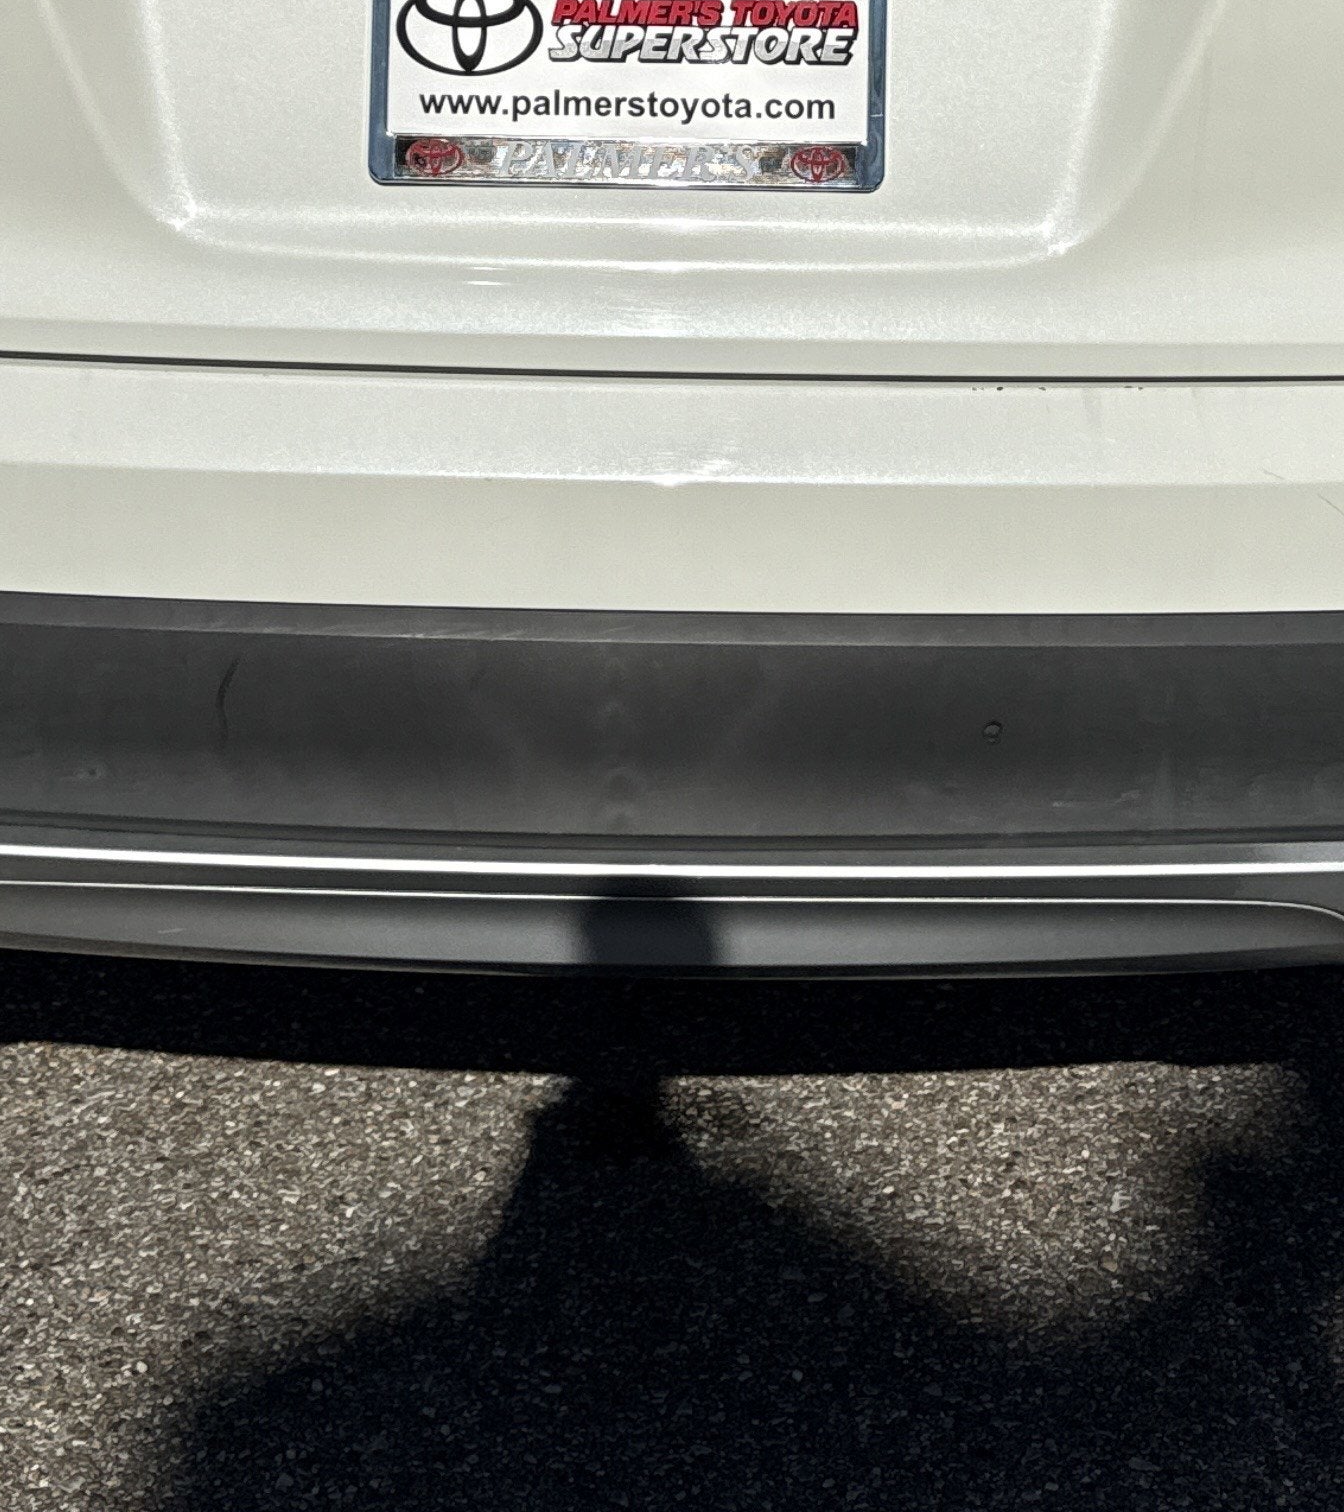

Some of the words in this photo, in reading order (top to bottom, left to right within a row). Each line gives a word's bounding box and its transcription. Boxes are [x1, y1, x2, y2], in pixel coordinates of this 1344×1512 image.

[730, 0, 859, 28] TOYOTA
[548, 24, 857, 66] SUPERSTORE
[419, 89, 836, 125] www.palmerstoyota.com
